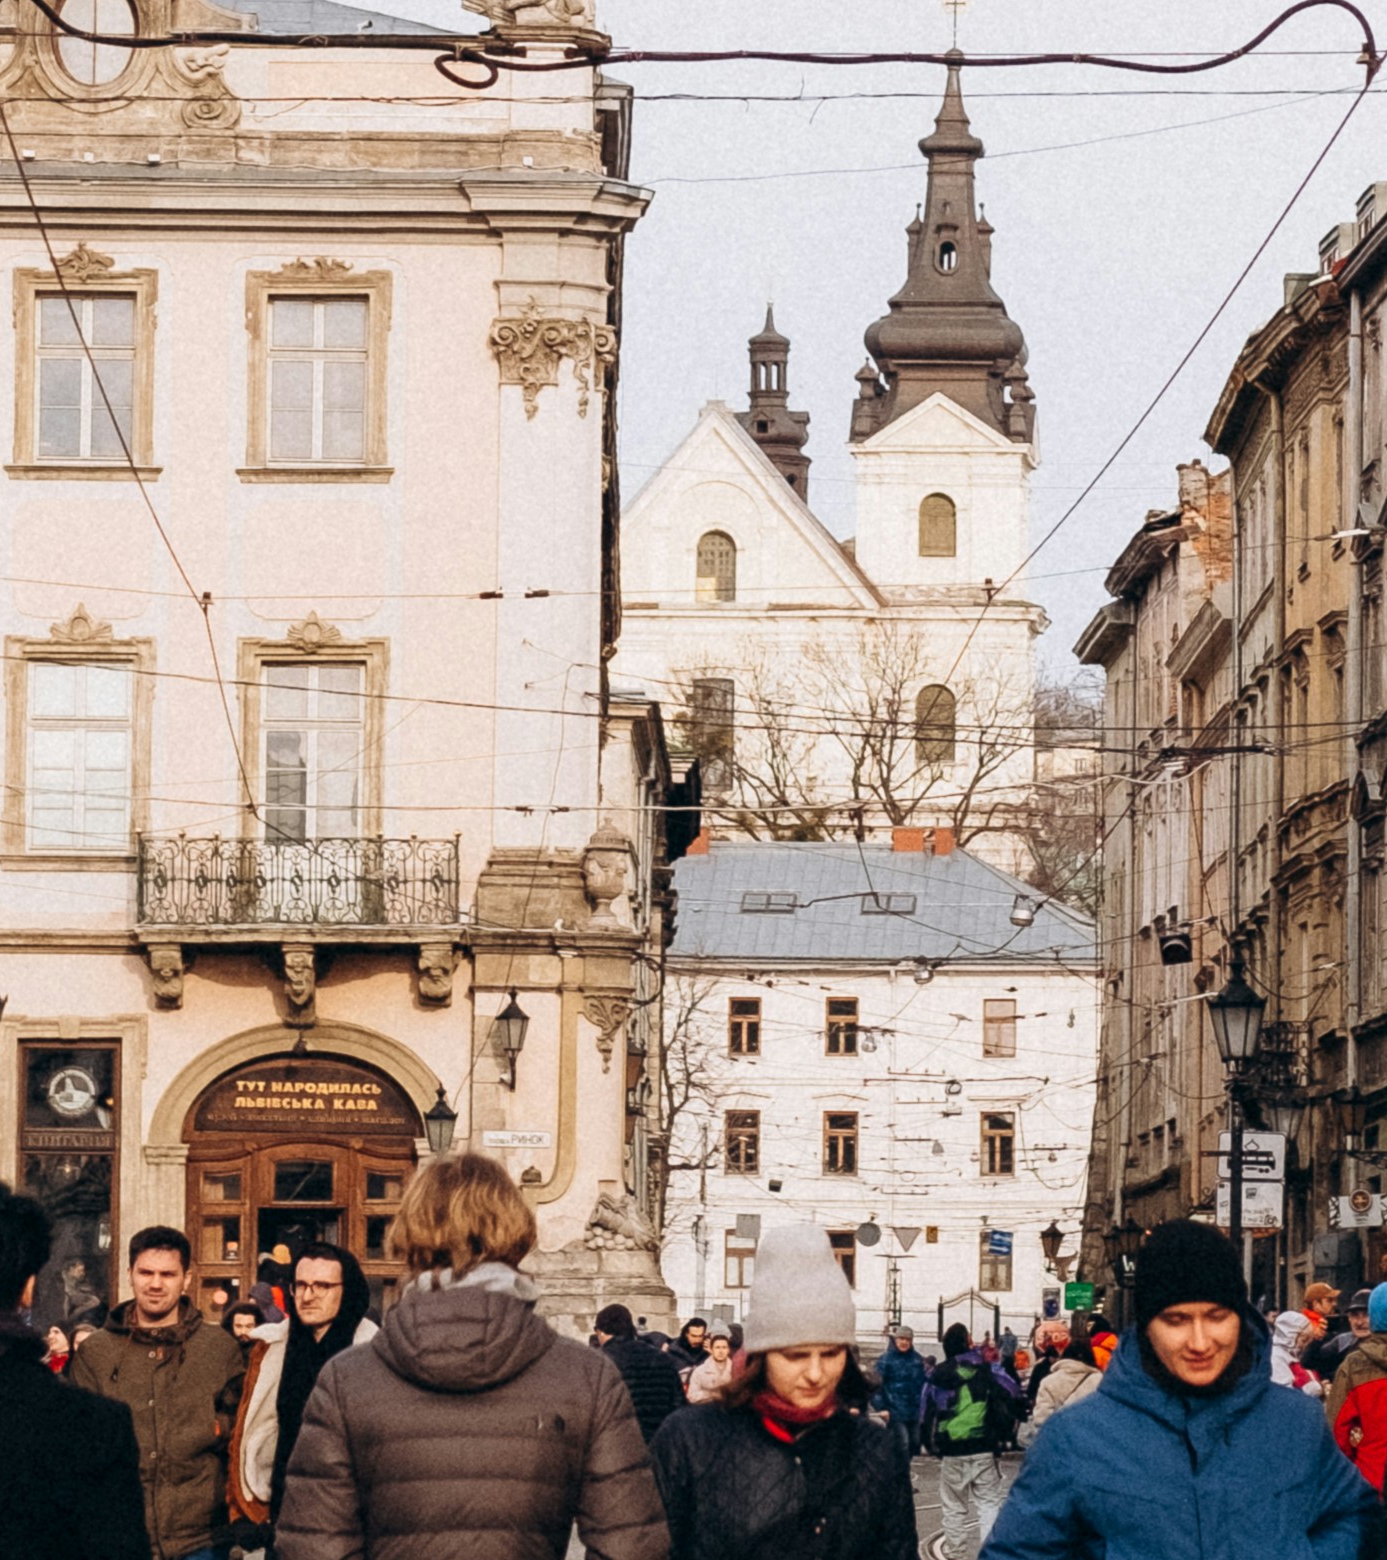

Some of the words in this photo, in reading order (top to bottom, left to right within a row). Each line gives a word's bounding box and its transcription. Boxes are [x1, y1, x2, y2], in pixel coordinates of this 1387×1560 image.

[236, 1081, 266, 1092] ТУТ
[271, 1082, 383, 1095] НАРОДИЛАСЬ
[234, 1097, 325, 1110] ЛЬВІВСЬКА
[333, 1099, 378, 1110] КАВА
